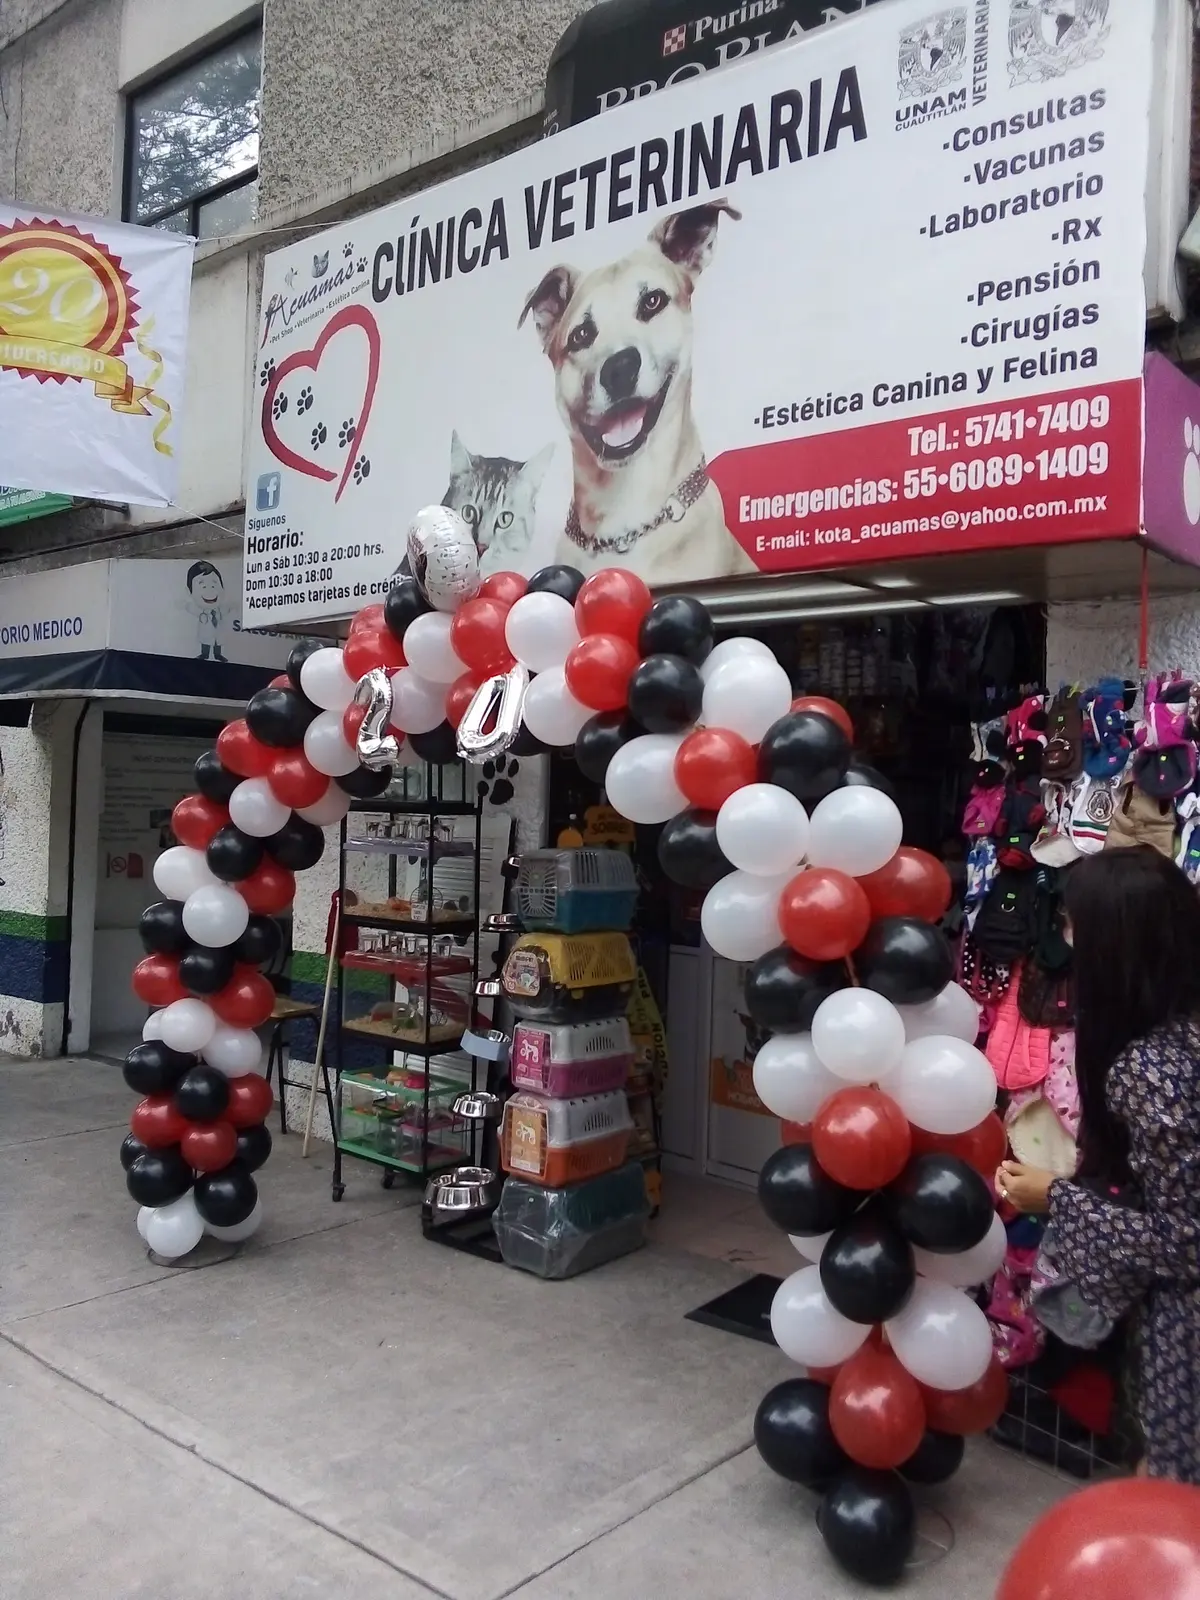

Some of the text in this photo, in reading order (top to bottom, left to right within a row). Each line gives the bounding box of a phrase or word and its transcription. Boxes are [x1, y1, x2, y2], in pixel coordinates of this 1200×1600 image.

[693, 0, 779, 43] Purina
[895, 87, 967, 123] UNAM
[524, 66, 867, 251] VETERINARIA
[0, 266, 104, 322] 20
[872, 371, 968, 407] Canina
[977, 365, 994, 393] y
[1003, 346, 1098, 383] Felina
[908, 423, 959, 457] Tel.:
[739, 477, 898, 524] Emergencias:
[247, 528, 304, 555] Horario:
[756, 495, 1108, 552] E-mail: kota_acuamas@yahoo.com.mx
[246, 543, 384, 574] Lun a Sáb 10:30 a 20:00 hrs.
[246, 567, 332, 591] Dom 10:30 a 18:00
[308, 585, 350, 604] tarjetas
[353, 582, 367, 597] de
[0, 616, 83, 645] ORIO MEDICO
